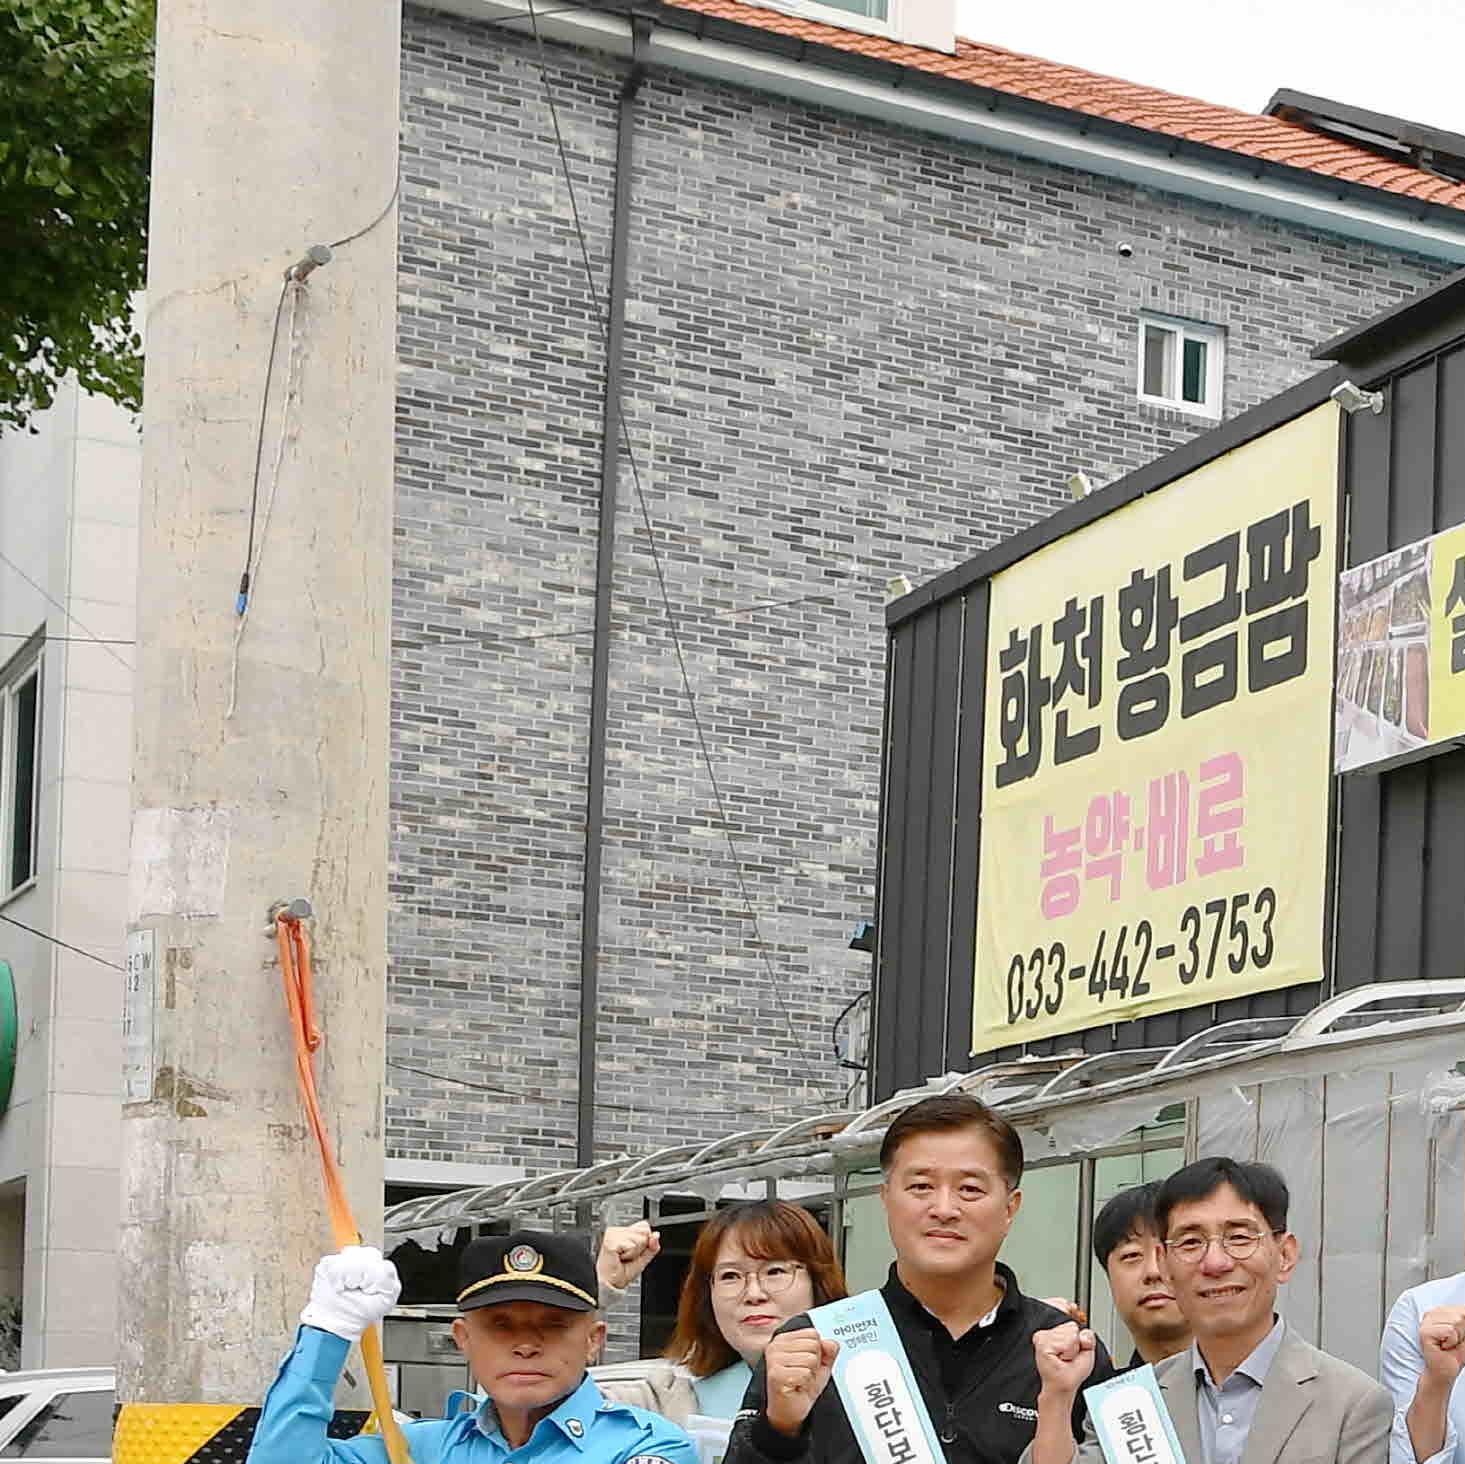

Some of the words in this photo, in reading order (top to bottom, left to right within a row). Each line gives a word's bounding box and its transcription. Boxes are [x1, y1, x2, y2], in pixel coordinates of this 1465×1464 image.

[995, 595, 1104, 789] 화천
[1117, 500, 1321, 741] 황금팜
[1006, 886, 1277, 1025] 033-442-3753
